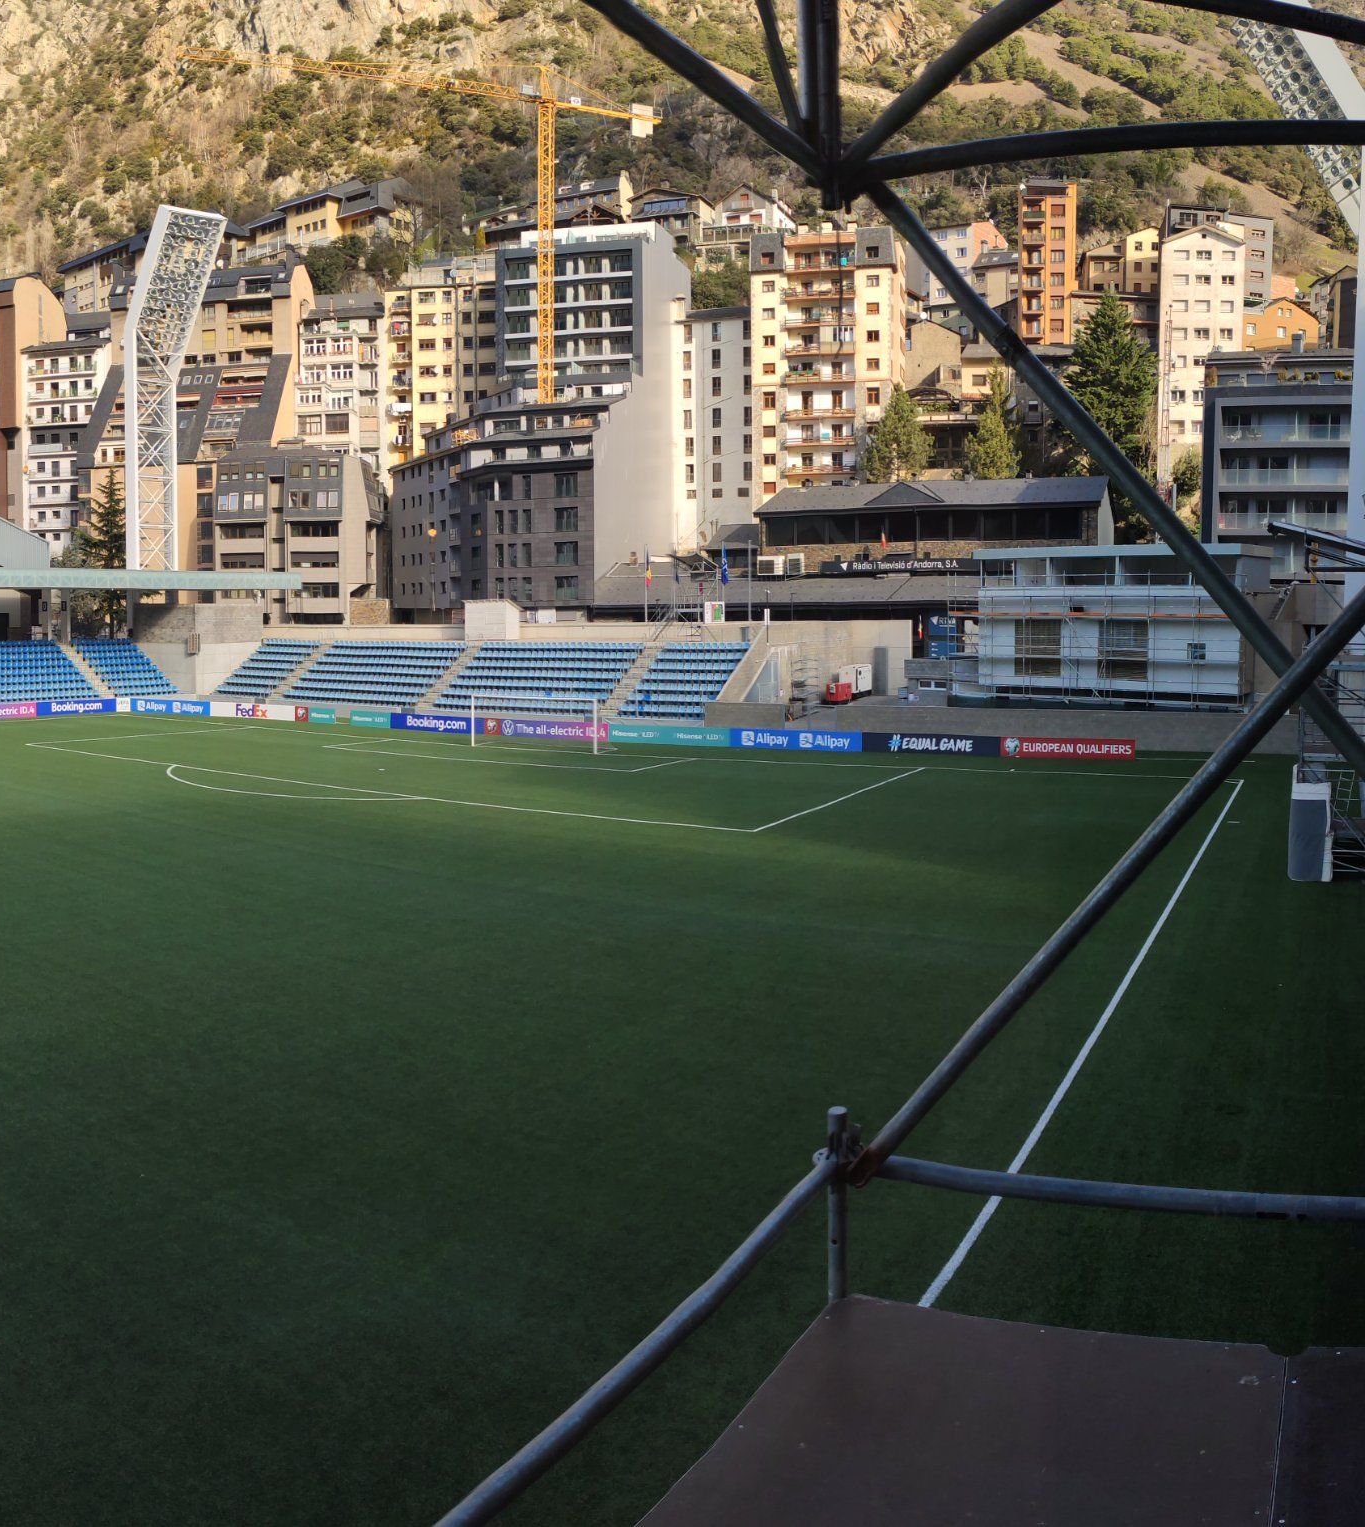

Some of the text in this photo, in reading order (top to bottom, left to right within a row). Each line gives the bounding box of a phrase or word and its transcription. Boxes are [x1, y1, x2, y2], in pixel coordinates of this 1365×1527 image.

[852, 561, 872, 570] Ràdio
[877, 561, 906, 569] Televisió
[20, 706, 35, 714] ID.4
[51, 702, 102, 713] Booking.com
[146, 702, 166, 712] Alipay
[181, 704, 204, 714] Alipay
[236, 704, 267, 718] FedEx
[406, 716, 466, 730] Booking.com
[516, 724, 534, 734] The
[535, 725, 583, 736] all-electric
[756, 732, 789, 747] Alipay
[814, 735, 850, 749] Alipay
[888, 734, 973, 752] #EQUAL GAME
[1023, 742, 1131, 755] EUROPEAN QUALIFIERS
